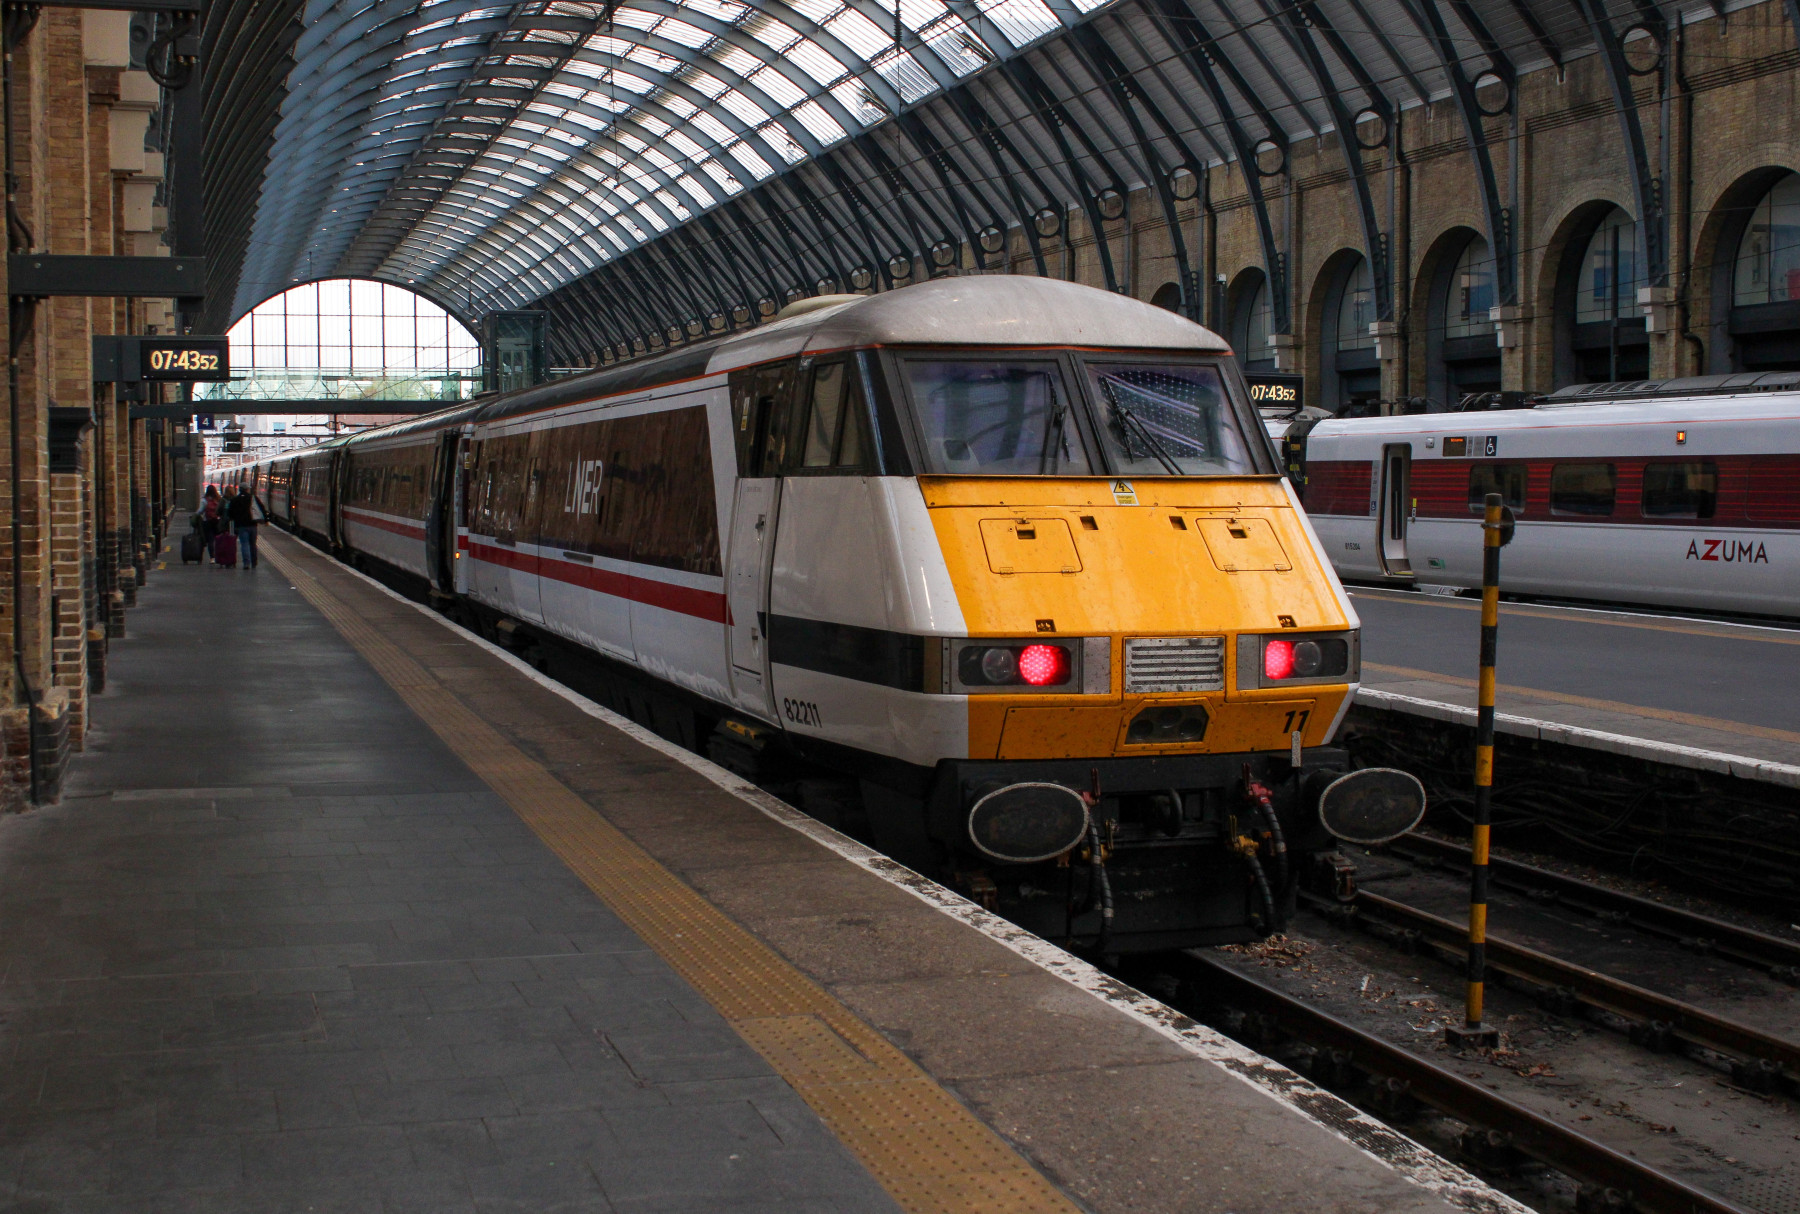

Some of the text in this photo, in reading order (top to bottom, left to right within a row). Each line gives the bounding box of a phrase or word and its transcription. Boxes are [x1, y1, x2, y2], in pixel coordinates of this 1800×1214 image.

[202, 417, 210, 427] 4
[564, 450, 603, 523] LNER
[1686, 538, 1769, 564] AZUMA
[783, 697, 823, 728] 82211
[1282, 709, 1310, 734] 11
